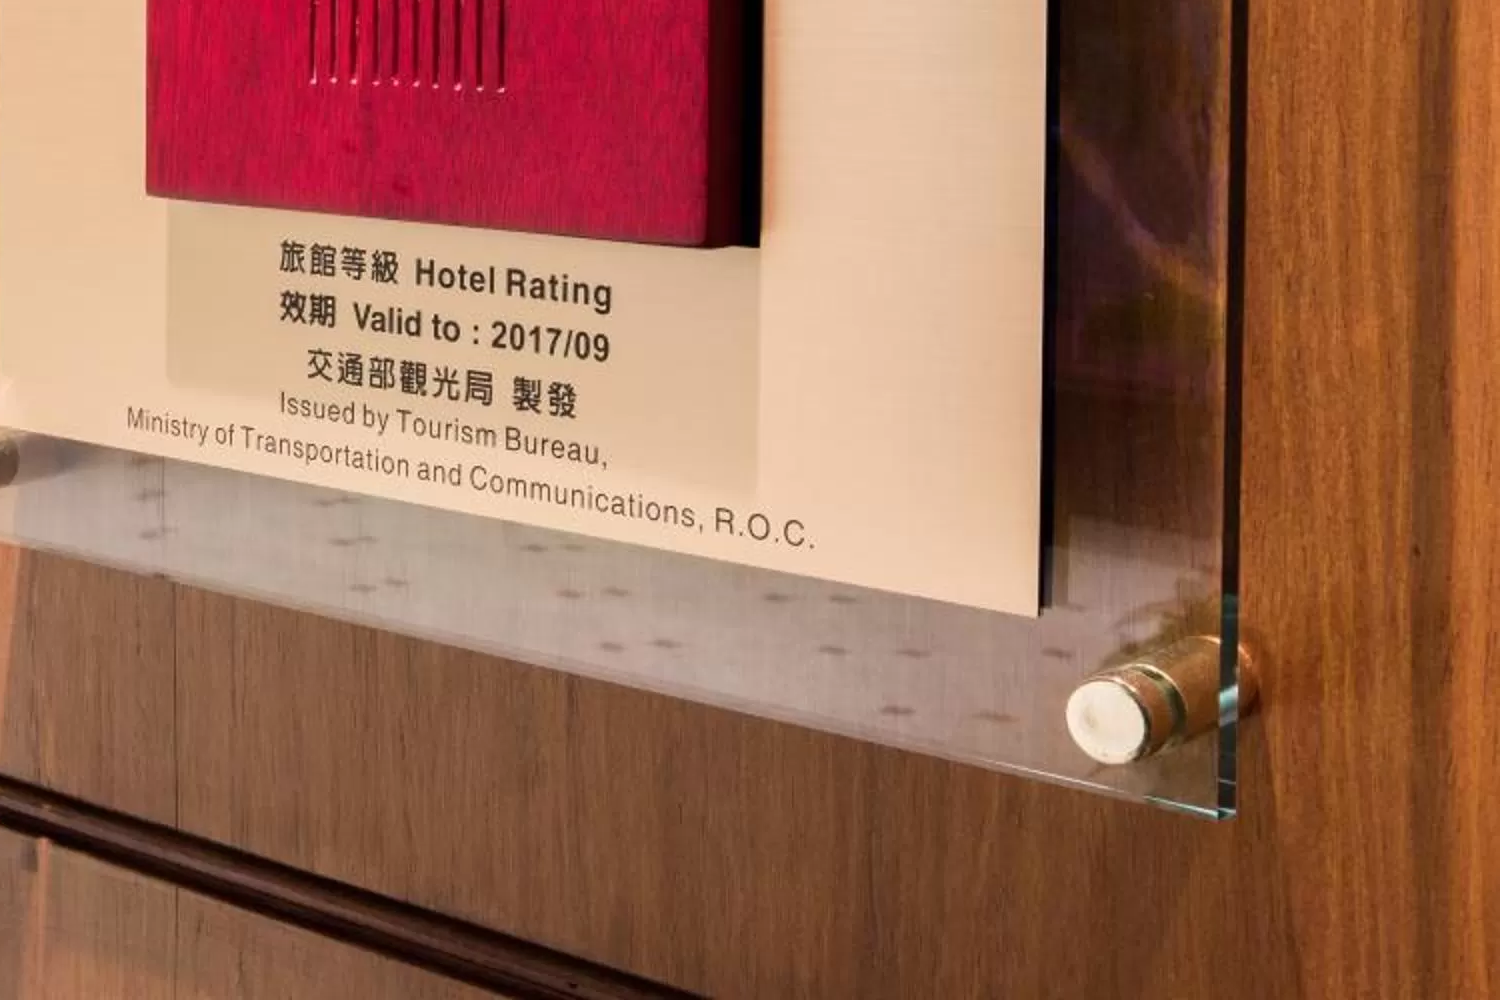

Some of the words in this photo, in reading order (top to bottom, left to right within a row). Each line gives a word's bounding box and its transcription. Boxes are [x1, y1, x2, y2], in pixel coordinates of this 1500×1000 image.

[279, 239, 399, 284] 旅館等級
[416, 257, 495, 294] Hotel
[507, 268, 612, 315] Rating
[279, 290, 336, 328] 效期
[353, 302, 421, 337] Valid
[433, 315, 461, 343] to
[491, 320, 610, 362] 2017/09
[307, 348, 494, 407] 交通部觀光局
[513, 375, 577, 420] 製發
[280, 391, 356, 425] Issued
[363, 404, 389, 435] by
[396, 408, 497, 449] Tourism
[505, 426, 608, 470] Bureau,
[127, 406, 208, 447] Ministry
[215, 423, 235, 446] of
[240, 425, 409, 477] Transportation
[417, 461, 462, 488] and
[469, 465, 704, 532] Communications,
[714, 507, 816, 550] R.O.C.
